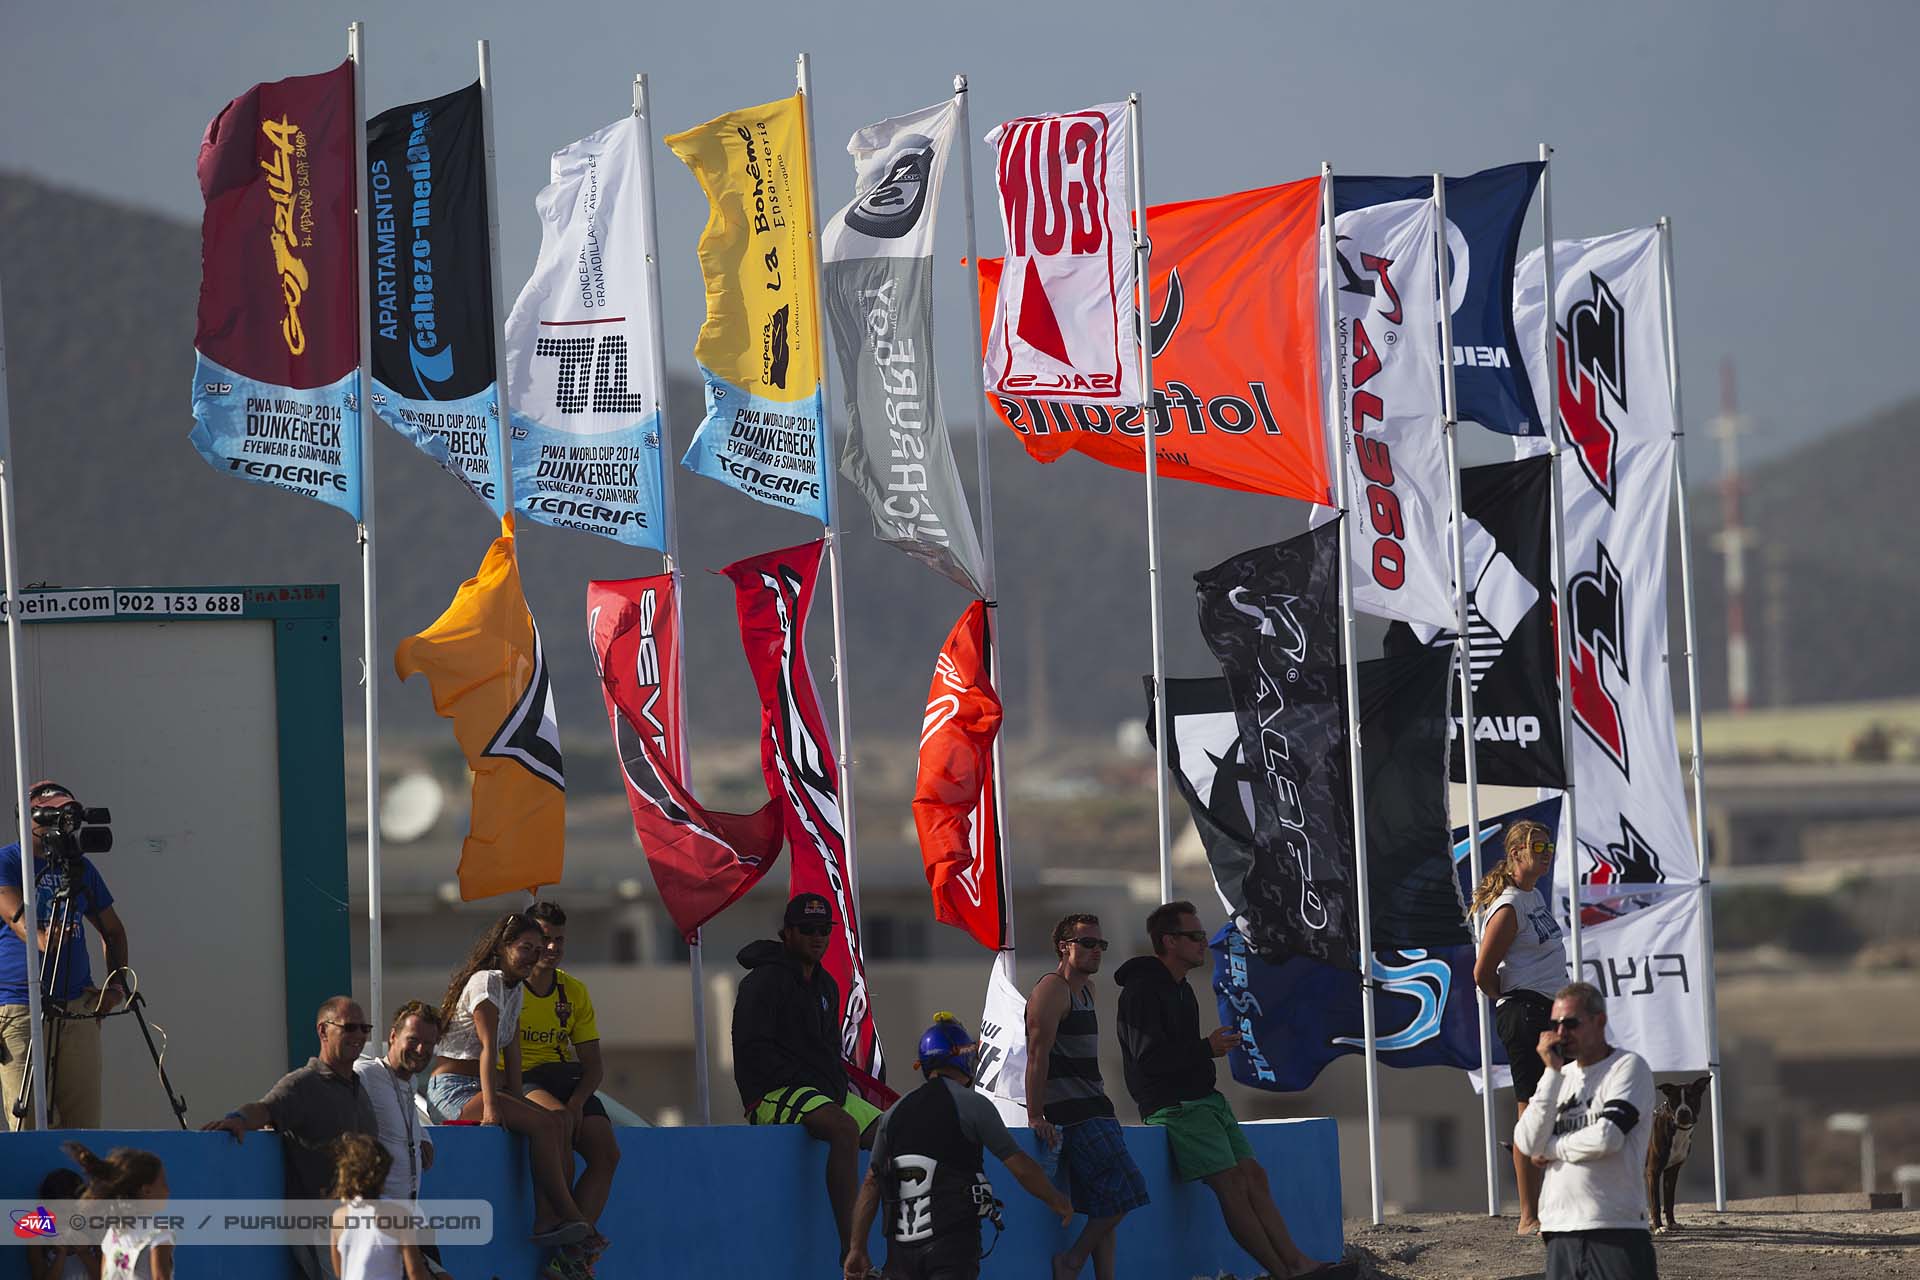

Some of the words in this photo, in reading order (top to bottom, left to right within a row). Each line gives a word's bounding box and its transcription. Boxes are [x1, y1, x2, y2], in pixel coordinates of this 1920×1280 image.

[737, 126, 770, 235] Bohême
[373, 160, 398, 341] APARTAMENTOS
[587, 231, 606, 307] GRANADILLA
[764, 247, 783, 291] La
[247, 398, 272, 413] PWA
[315, 406, 341, 421] 2014
[447, 414, 464, 429] CUP
[466, 415, 486, 431] 2014
[736, 408, 760, 425] PWA
[763, 412, 783, 427] WORLD
[784, 415, 796, 430] CUP
[797, 417, 816, 432] 2014
[243, 440, 288, 457] EYEWEAR
[290, 445, 296, 457] &
[541, 445, 566, 460] PWA
[569, 447, 597, 461] WORLD
[599, 446, 614, 461] CUP
[616, 447, 640, 462] 2014
[730, 421, 816, 458] DUNKERBECK
[1352, 318, 1405, 591] AL360
[727, 439, 774, 466] EYEWEAR
[775, 455, 781, 467] &
[798, 459, 816, 475] PARK
[226, 457, 347, 492] TENERIFE
[536, 460, 639, 487] DUNKERBECK
[716, 454, 820, 500] TENERIFE
[536, 480, 584, 495] EYEWEAR
[585, 488, 594, 498] &
[595, 488, 618, 503] SIAM
[618, 489, 639, 504] PARK
[527, 497, 648, 529] TENERIFE
[119, 595, 154, 611] 902
[164, 595, 197, 612] 153
[205, 596, 241, 612] 688
[520, 1026, 556, 1042] nicef
